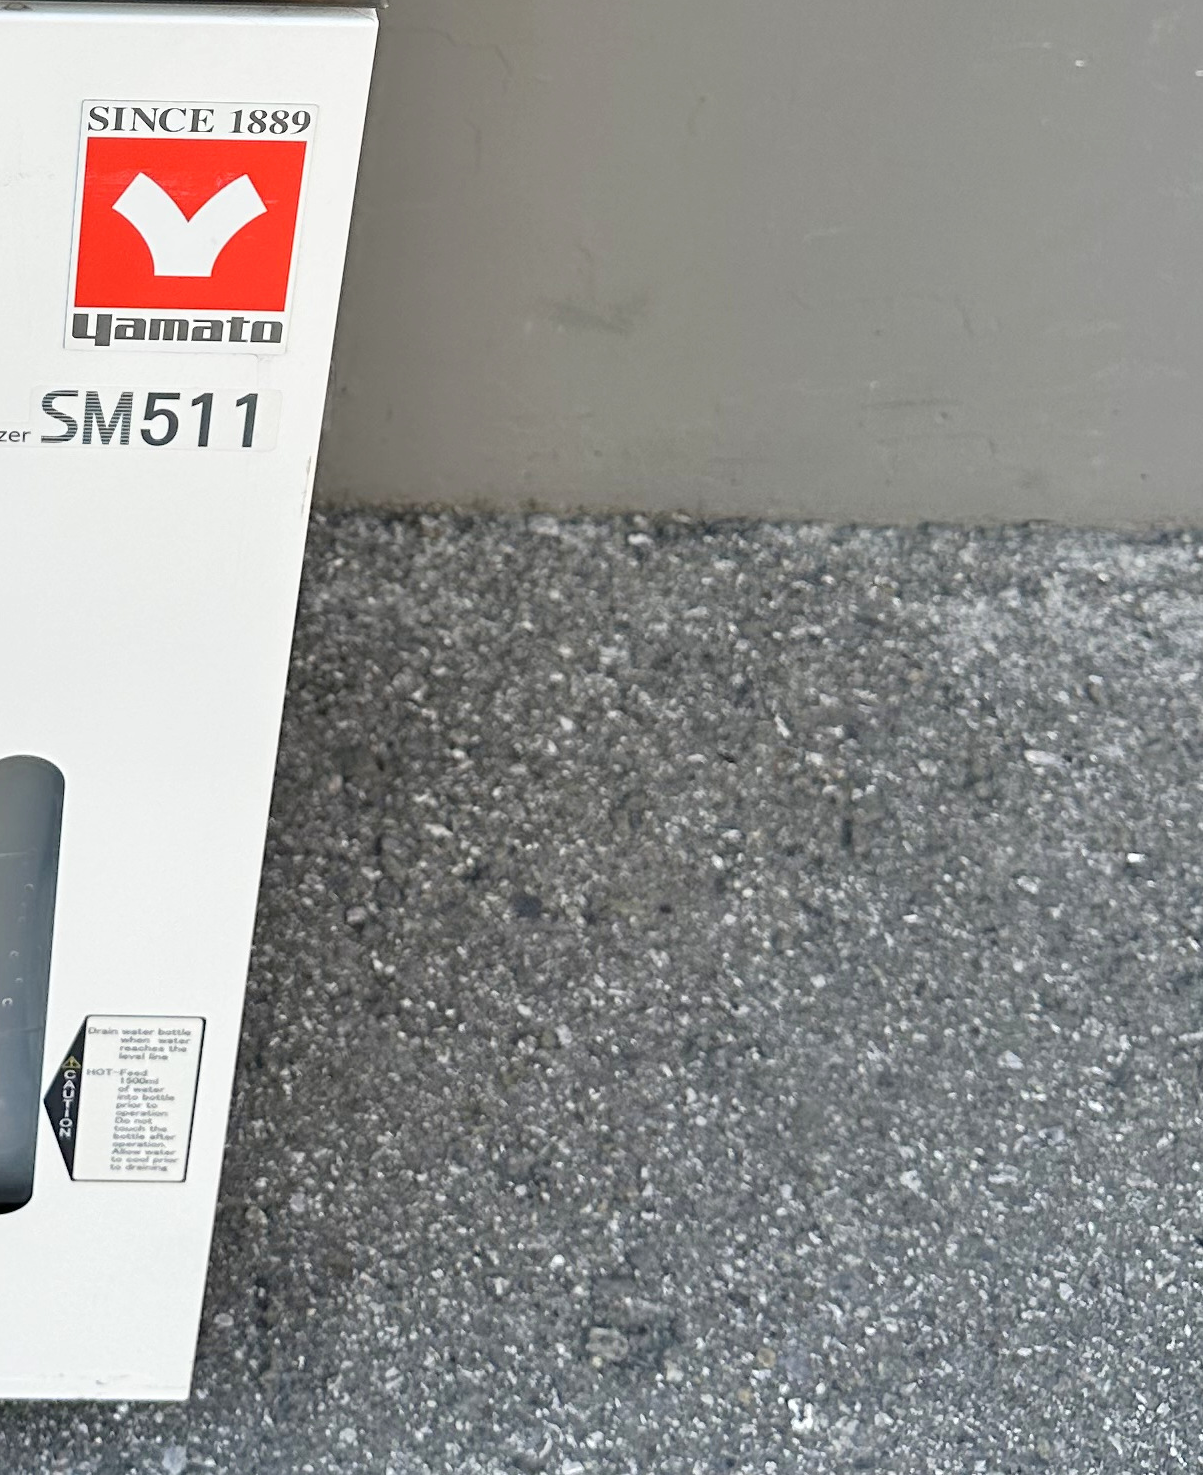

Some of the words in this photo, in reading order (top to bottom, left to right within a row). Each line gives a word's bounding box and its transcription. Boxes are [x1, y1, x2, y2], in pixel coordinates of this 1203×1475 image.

[87, 105, 215, 134] SINCE
[228, 109, 312, 135] 1889
[71, 313, 284, 346] yamato
[40, 390, 259, 448] SM511
[158, 1028, 191, 1036] bottle
[59, 1070, 76, 1138] CAUTION
